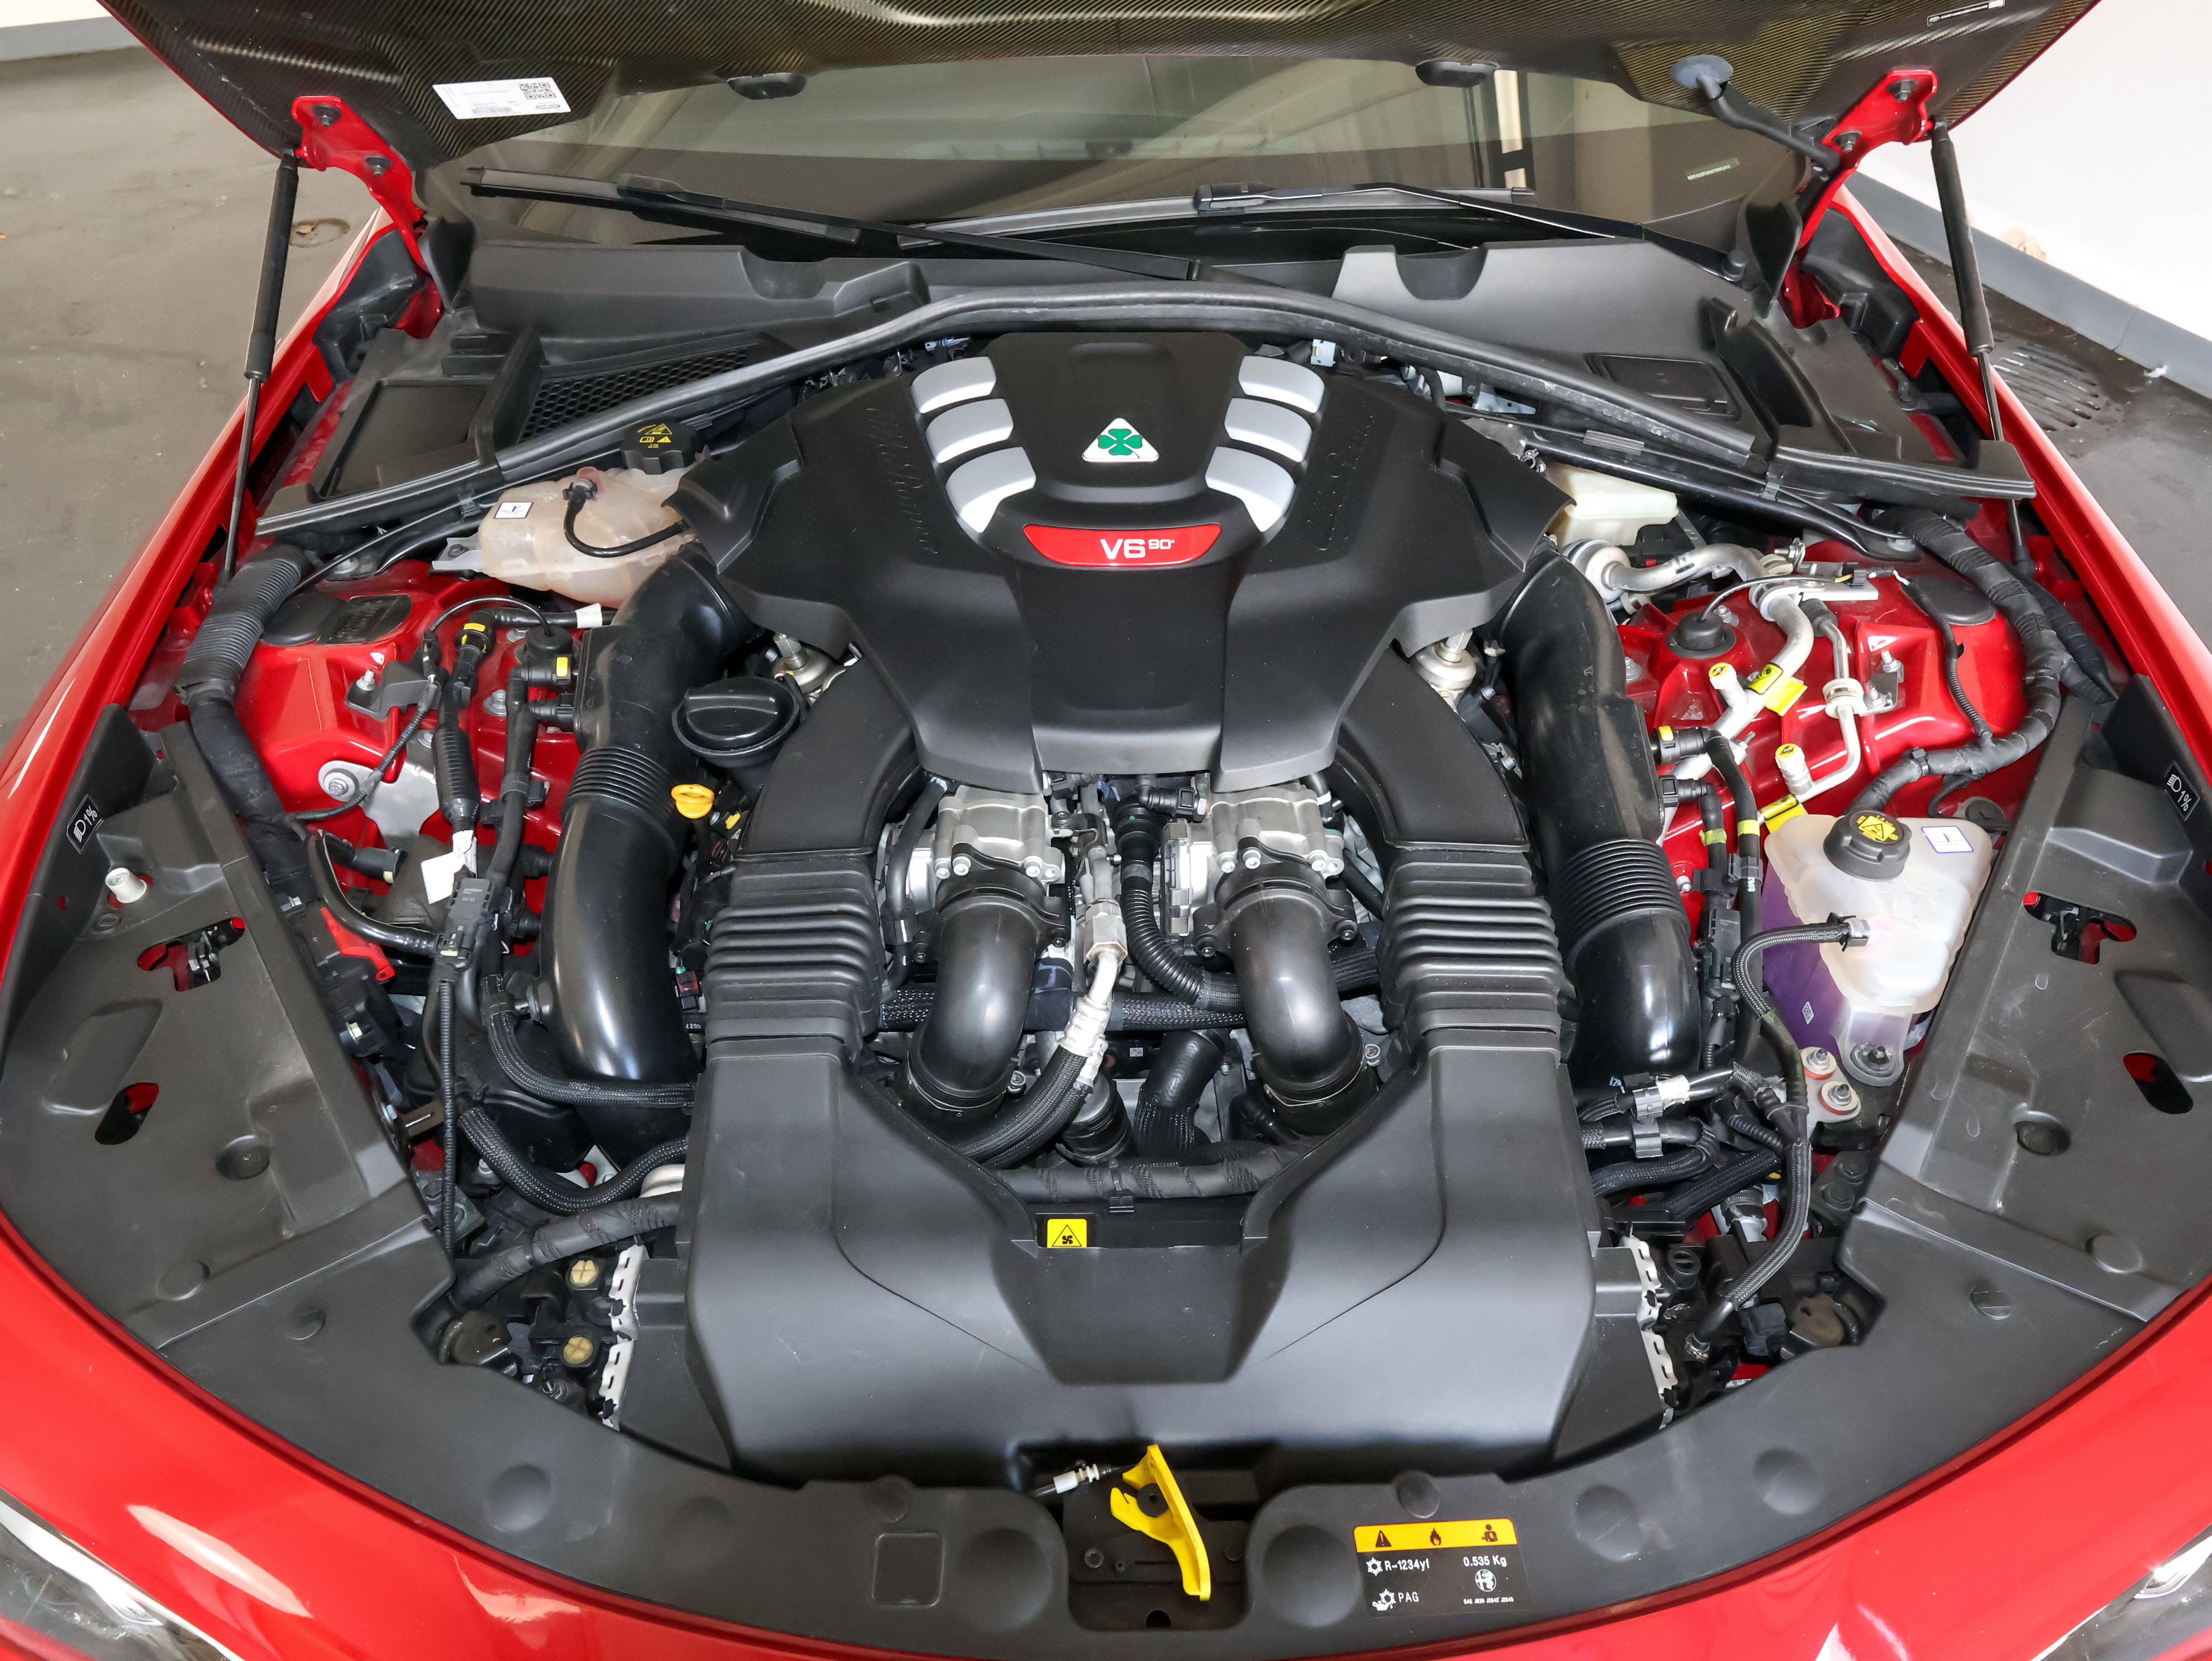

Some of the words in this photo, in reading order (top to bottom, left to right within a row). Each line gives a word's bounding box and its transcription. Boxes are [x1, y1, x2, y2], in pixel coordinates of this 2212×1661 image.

[1100, 539, 1145, 559] V6
[2178, 790, 2192, 811] 1%
[83, 805, 98, 826] 1%
[1384, 1558, 1429, 1571] R-1234yf
[1463, 1556, 1490, 1567] 0.535
[1492, 1555, 1507, 1567] Kg
[1398, 1592, 1419, 1603] PAG
